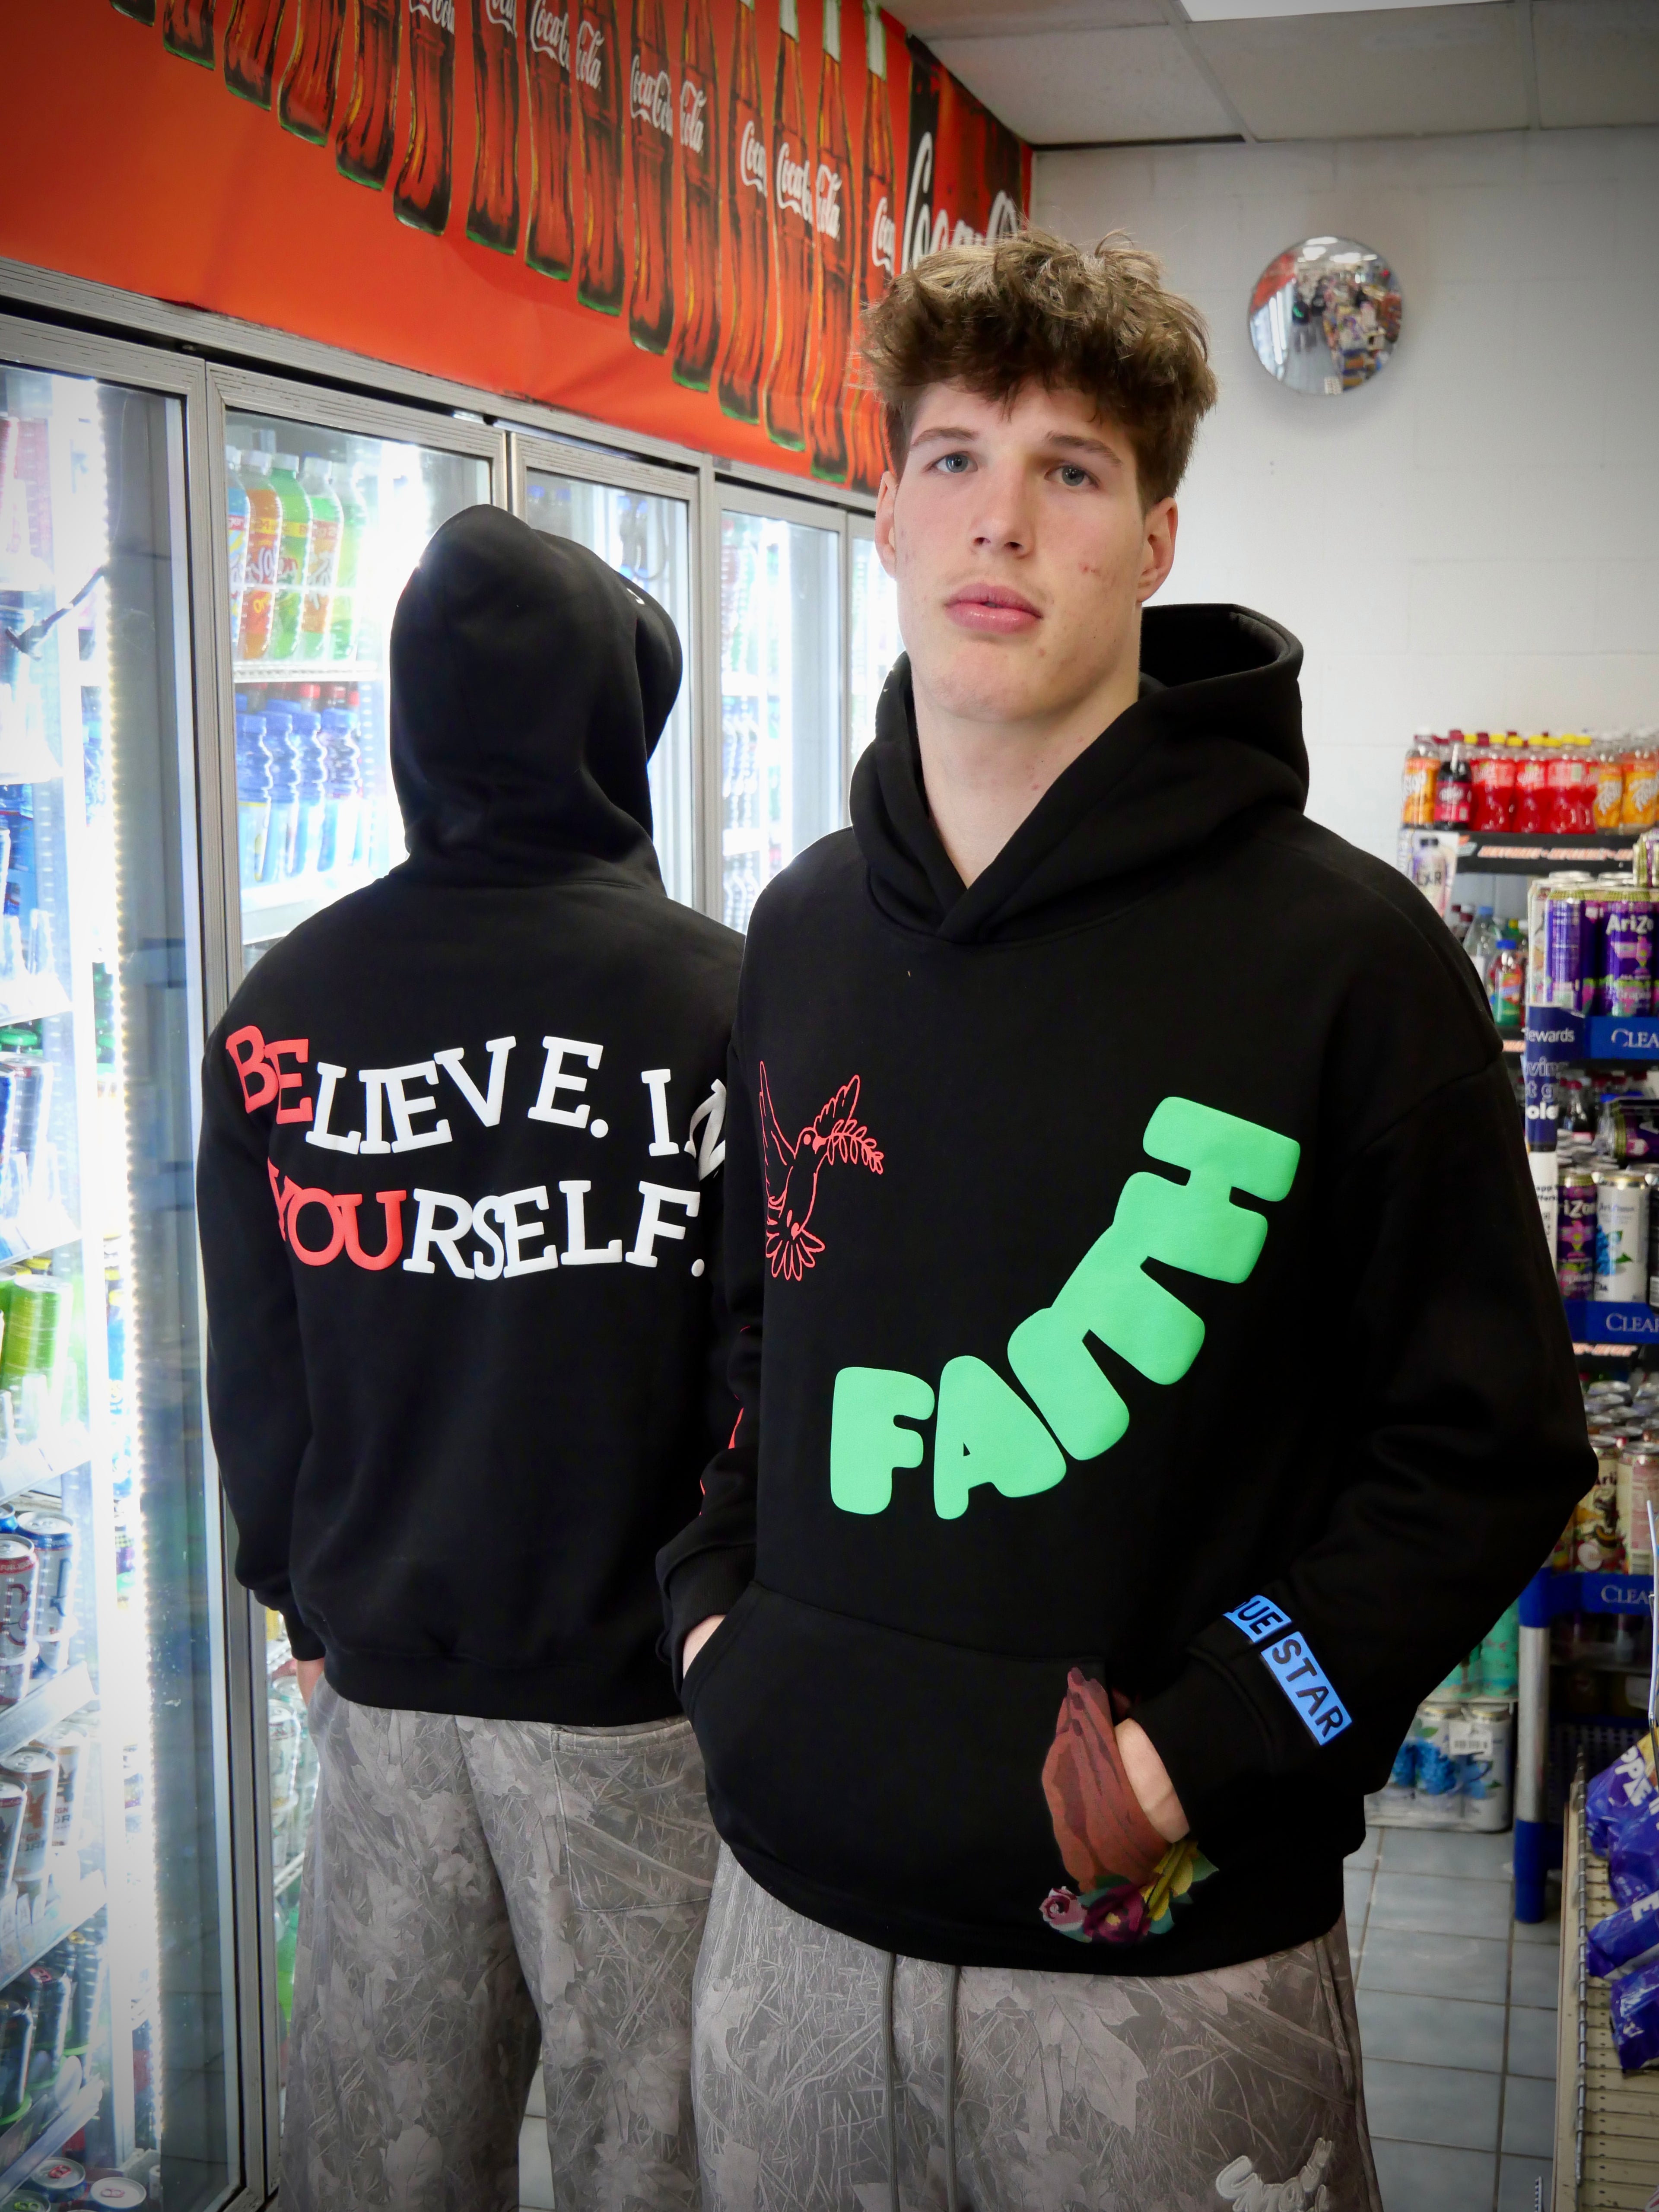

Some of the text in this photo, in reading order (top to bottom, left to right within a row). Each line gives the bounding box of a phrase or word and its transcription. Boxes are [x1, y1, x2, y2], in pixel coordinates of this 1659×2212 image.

[226, 1025, 609, 1155] BELIEVE.
[267, 1156, 705, 1281] YOURSELF.
[830, 1096, 1301, 1520] FAITH
[1605, 1312, 1659, 1332] CLEA
[1601, 1584, 1654, 1605] CLEA
[1234, 1599, 1344, 1738] UE STAR
